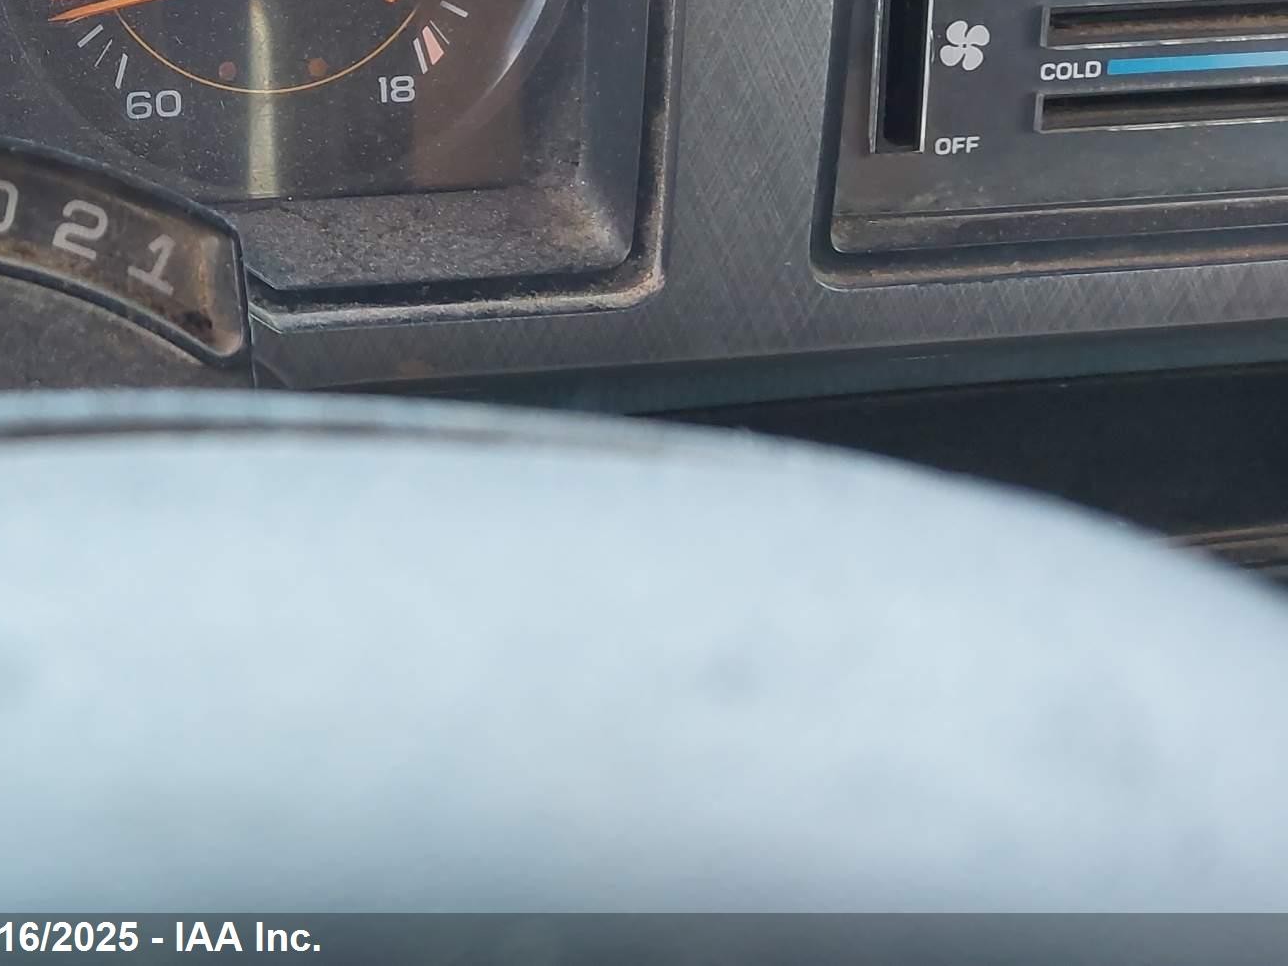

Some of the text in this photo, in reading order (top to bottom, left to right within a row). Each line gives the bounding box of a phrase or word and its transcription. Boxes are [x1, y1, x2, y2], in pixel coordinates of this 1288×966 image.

[1040, 61, 1102, 81] COLD
[377, 76, 416, 104] 18
[126, 90, 182, 119] 60
[934, 137, 981, 156] OFF
[52, 198, 109, 261] 2
[128, 233, 176, 296] 1
